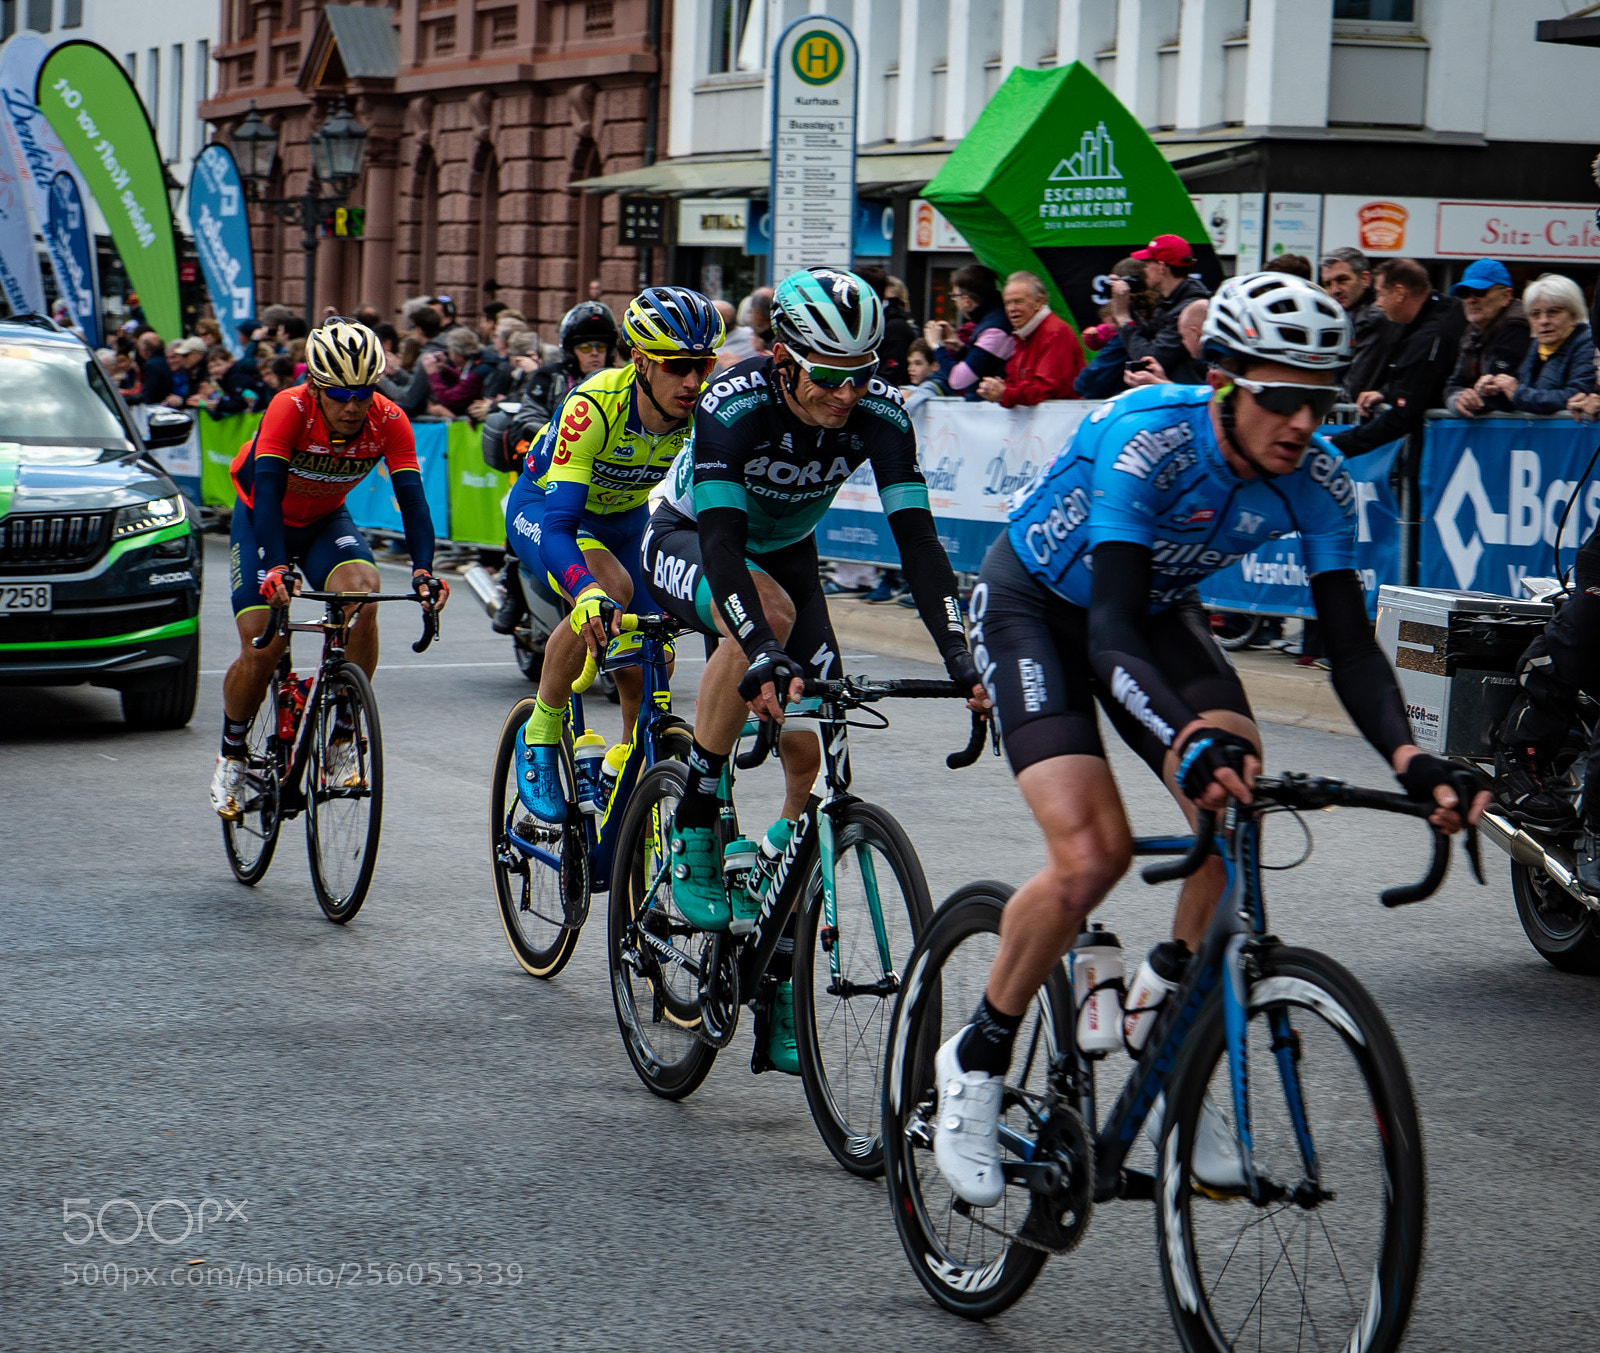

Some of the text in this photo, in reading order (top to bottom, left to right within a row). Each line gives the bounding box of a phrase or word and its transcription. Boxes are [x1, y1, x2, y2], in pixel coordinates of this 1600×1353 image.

[794, 96, 840, 106] Kurhaus
[788, 118, 835, 132] Bussteig
[1044, 187, 1127, 202] ESCHBORN
[1039, 202, 1133, 218] FRANKFURT
[701, 370, 768, 414] BORA
[716, 391, 768, 421] hansgrohe
[858, 396, 909, 428] ansgrohe
[291, 452, 374, 475] BAHRAIN
[744, 456, 852, 486] BORA
[1025, 486, 1092, 566] Crelan
[149, 573, 193, 586] ŠKODA
[653, 549, 699, 602] BORA
[728, 592, 747, 623] BORA
